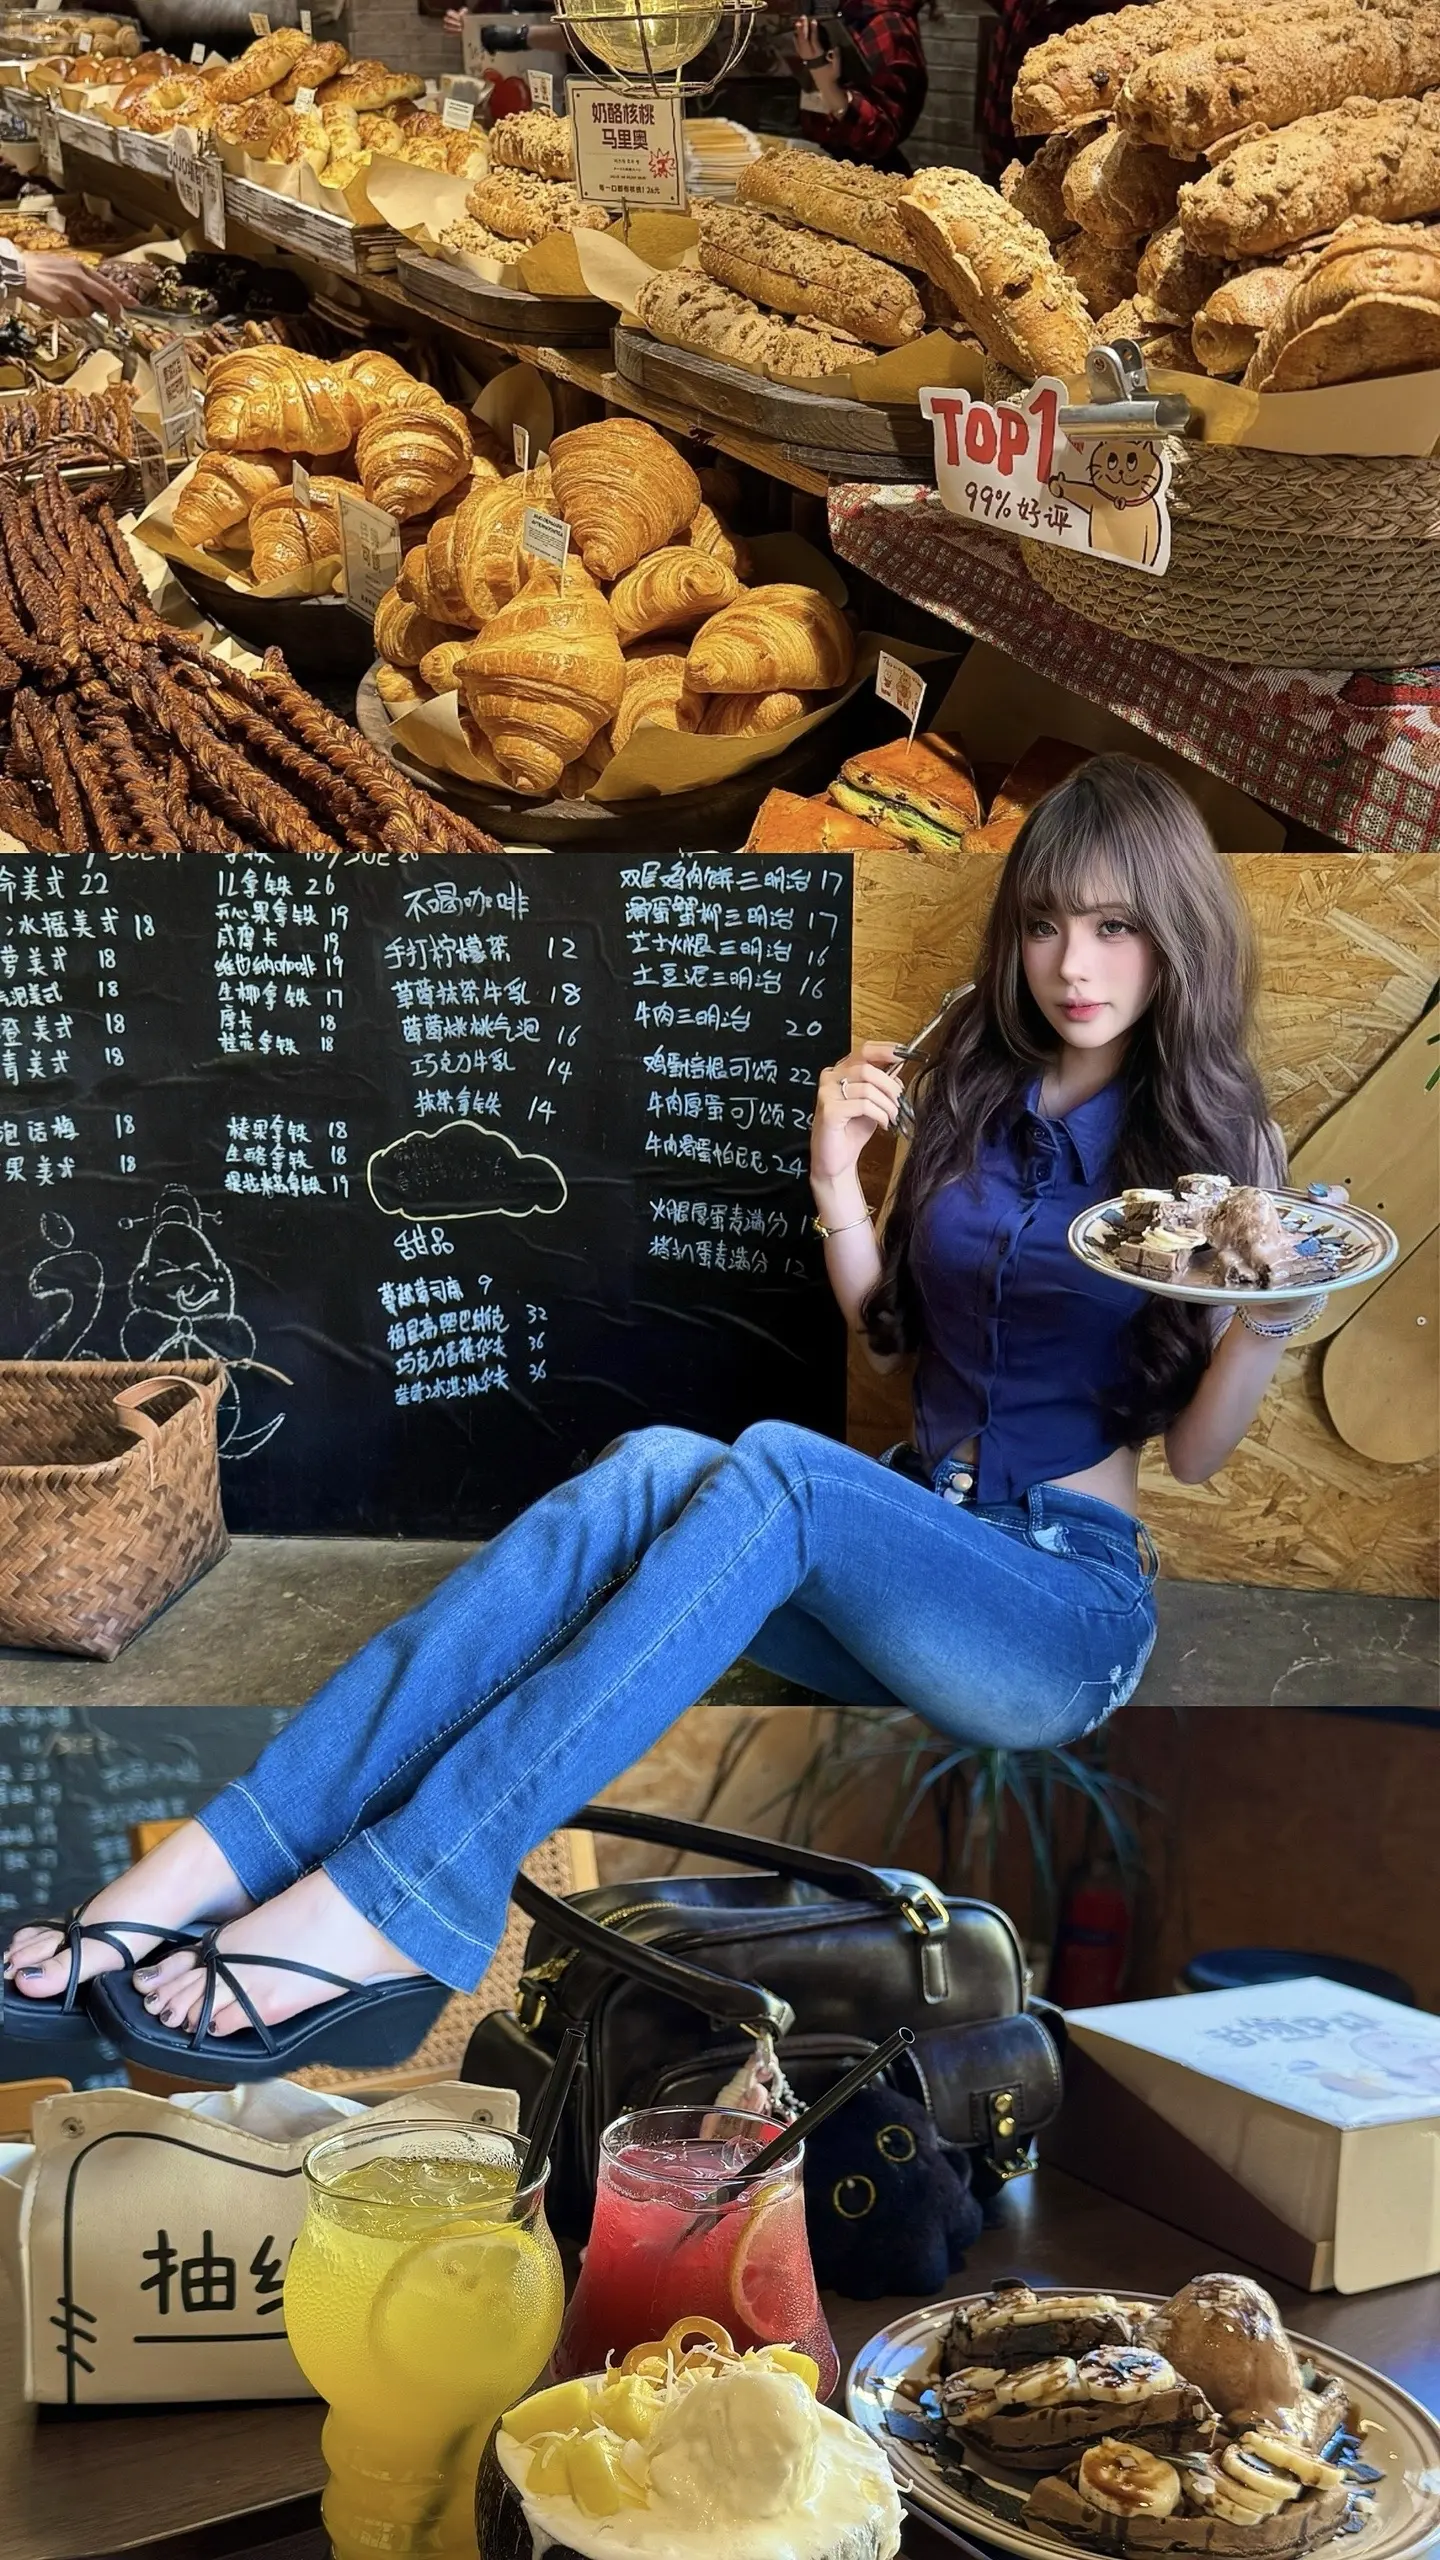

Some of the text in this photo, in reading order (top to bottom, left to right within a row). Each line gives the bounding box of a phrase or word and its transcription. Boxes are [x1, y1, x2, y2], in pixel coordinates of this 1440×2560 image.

[592, 103, 655, 125] 奶酪核桃
[602, 129, 649, 151] 马里奥
[930, 389, 1058, 484] TOP1
[79, 872, 109, 895] 22
[305, 874, 335, 896] 26
[620, 861, 843, 896] 双层鸡肉饼三明治 17
[215, 898, 349, 931] 开心果拿铁 19
[403, 881, 529, 923] 不喝咖啡
[134, 914, 155, 941] 18
[625, 895, 838, 940] 滑蛋蟹柳三明治 17
[324, 932, 339, 955] 19
[384, 933, 579, 970] 手打柠檬茶 12
[626, 930, 829, 966] 芝士火腿三明治 16
[98, 948, 116, 969] 18
[214, 951, 344, 978] 维也纳咖啡 19
[98, 980, 119, 998] 18
[391, 977, 582, 1010] 草莓抹茶牛乳 18
[633, 963, 825, 999] 土豆泥三明治 16
[218, 981, 343, 1011] 生椰拿铁 17
[105, 1012, 126, 1034] 18
[320, 1014, 337, 1031] 18
[634, 1001, 822, 1036] 牛肉三明治 20
[321, 1036, 334, 1052] 18
[557, 1025, 582, 1047] 16
[104, 1047, 125, 1067] 18
[410, 1048, 573, 1085] 巧克力牛乳 14
[643, 1045, 816, 1086] 鸡蛋培根可颂 22
[414, 1085, 557, 1125] 抹茶拿铁 14
[647, 1087, 785, 1129] 牛肉厚蛋可颂
[115, 1113, 136, 1139] 18
[328, 1121, 348, 1139] 18
[119, 1154, 137, 1174] 18
[331, 1145, 347, 1165] 18
[772, 1155, 807, 1179] 24
[333, 1175, 349, 1198] 19
[650, 1198, 788, 1238] 火腿厚蛋麦满分
[393, 1223, 455, 1261] 甜品
[785, 1258, 809, 1280] 12
[377, 1274, 493, 1317] 蔓越莓司康 9
[526, 1303, 548, 1324] 32
[395, 1332, 545, 1376] 巧克力香蕉华夫 36
